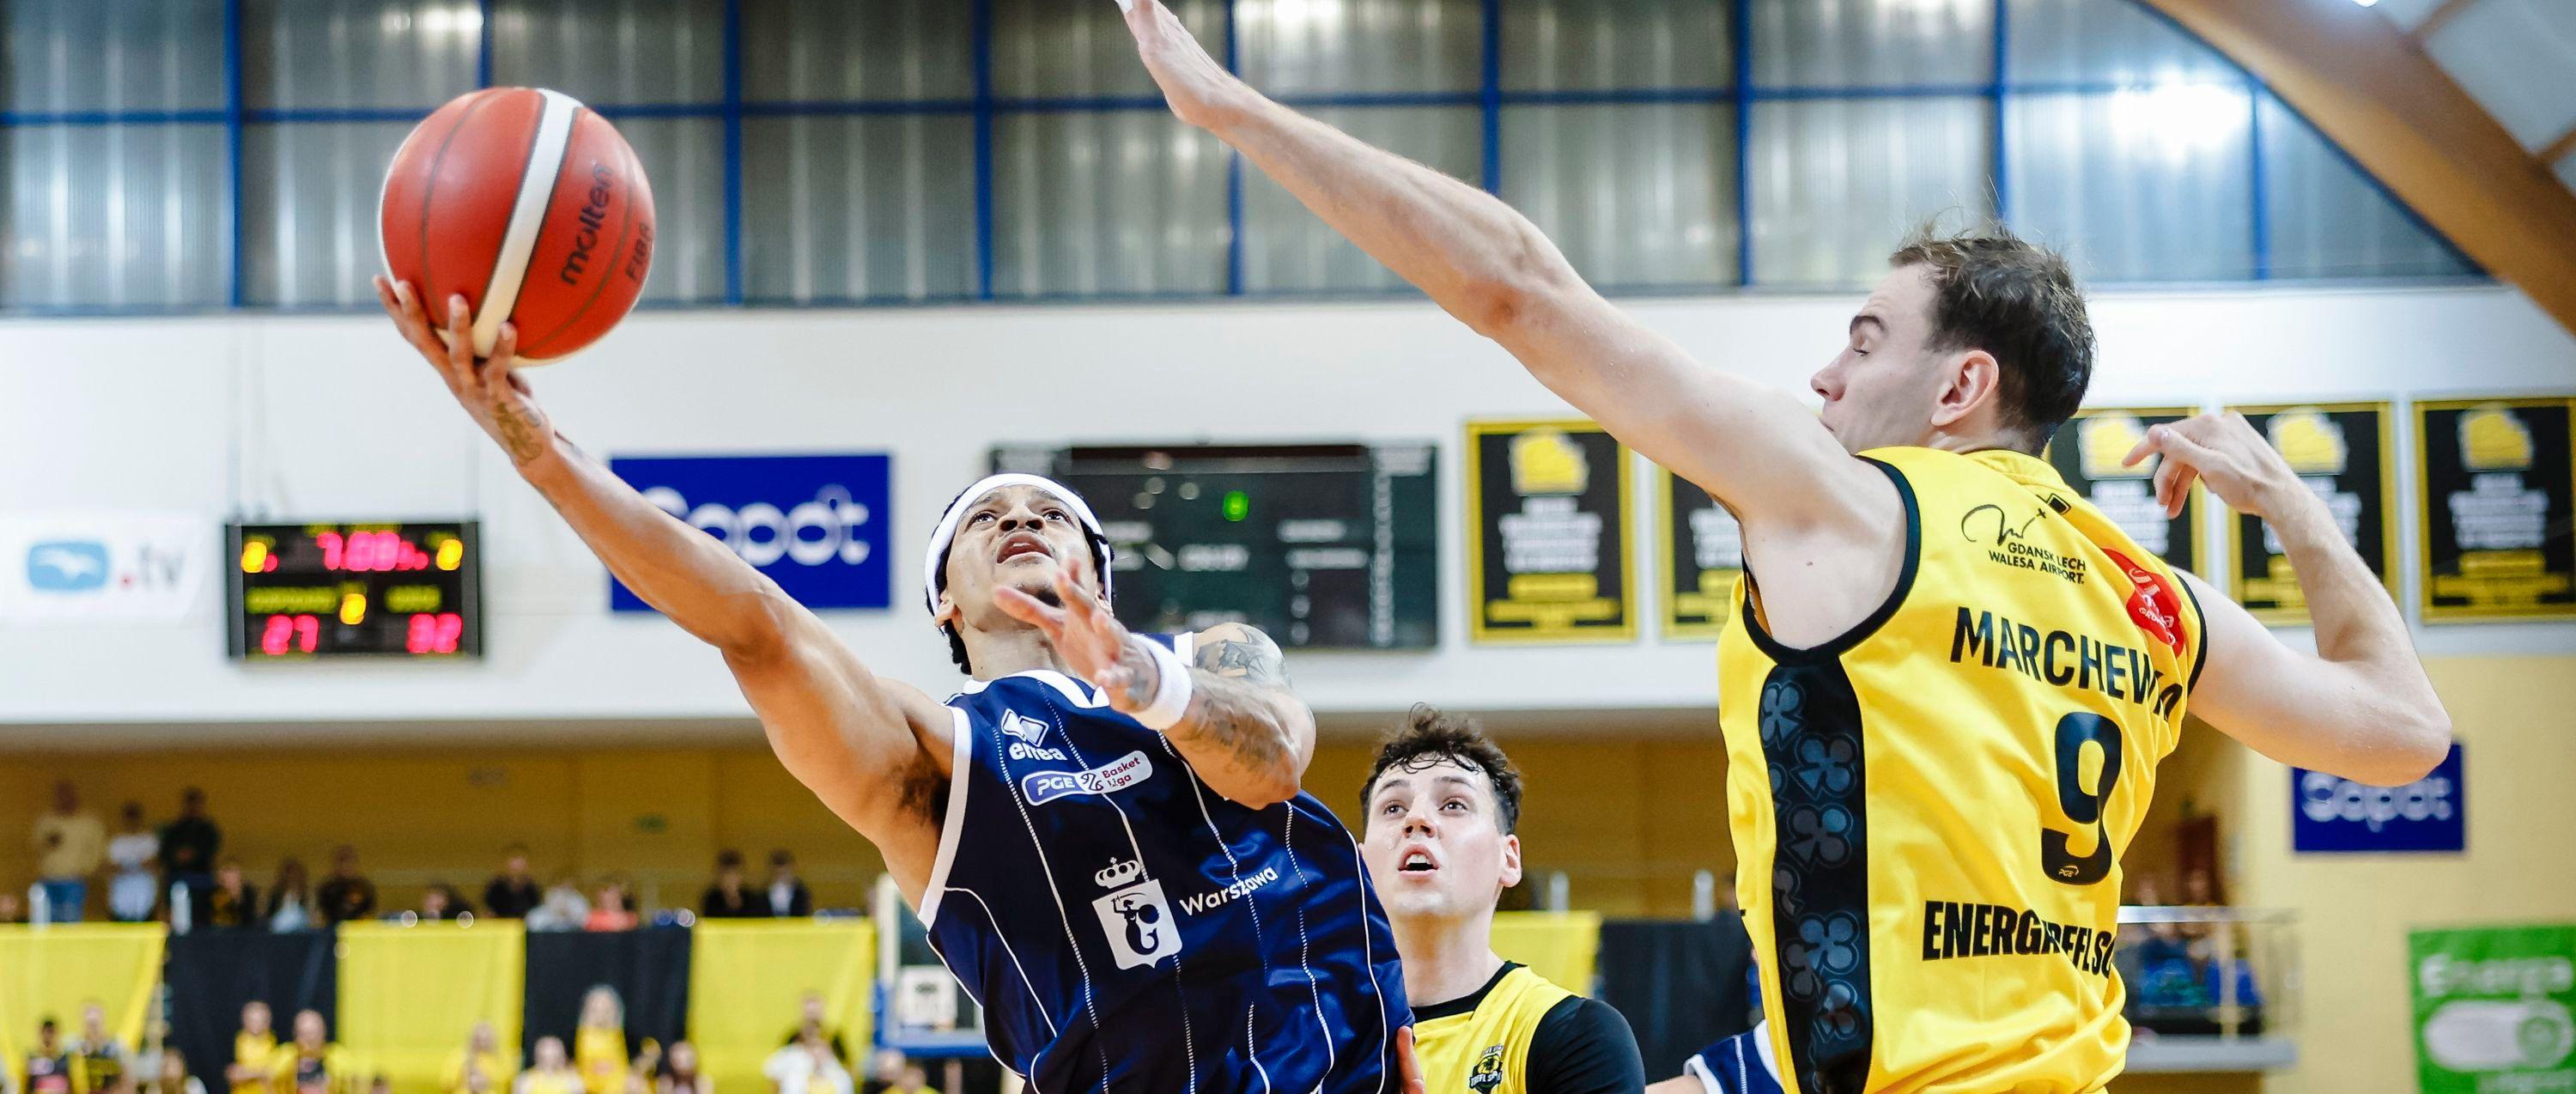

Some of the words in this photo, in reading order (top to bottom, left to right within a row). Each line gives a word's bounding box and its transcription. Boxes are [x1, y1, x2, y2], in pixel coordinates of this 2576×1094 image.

[560, 162, 613, 286] molten
[1988, 550, 2036, 571] WALESA
[2008, 542, 2056, 563] GDANSK
[2057, 555, 2087, 571] LECH
[1036, 776, 1077, 797] PGE
[1101, 756, 1141, 780] Basket
[2041, 711, 2123, 886] 9
[1179, 866, 1279, 917] Warszawa
